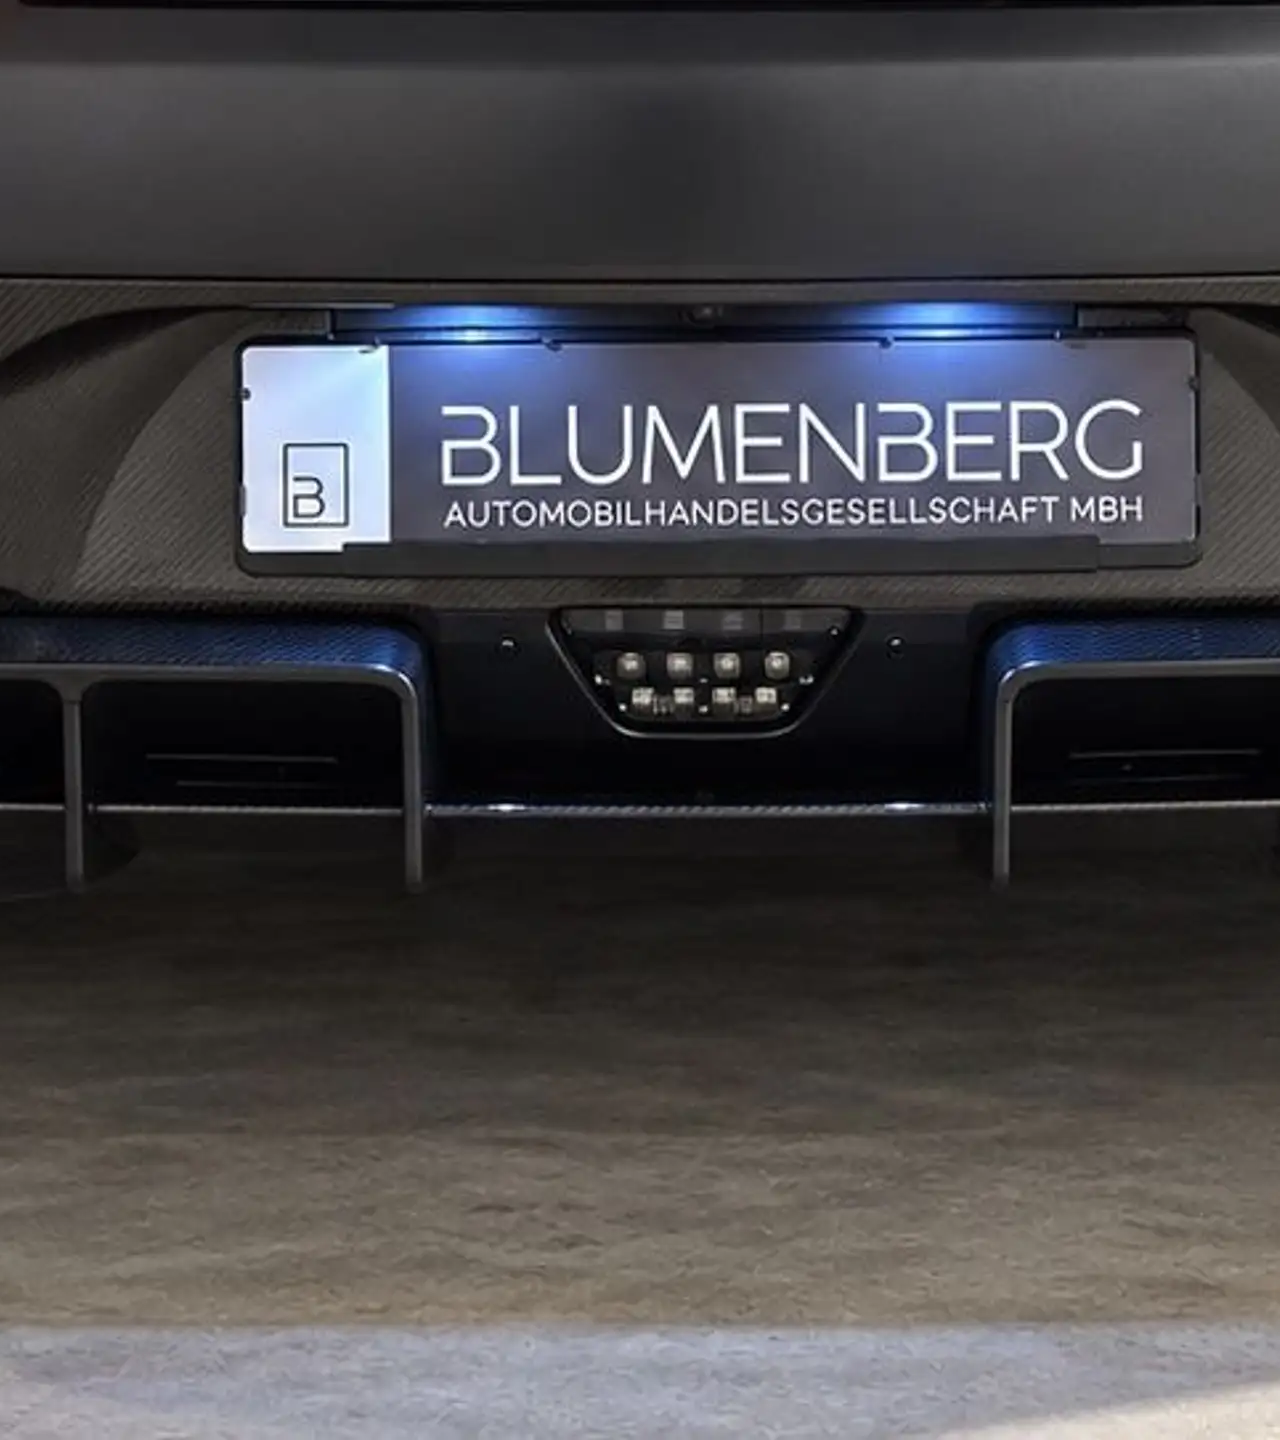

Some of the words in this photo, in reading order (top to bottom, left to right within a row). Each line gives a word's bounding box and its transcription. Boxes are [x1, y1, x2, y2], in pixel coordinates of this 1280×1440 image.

[440, 398, 1145, 487] BLUMENBERG
[292, 475, 326, 519] B
[443, 495, 1060, 530] AUTOMOBILHANDELSGESELLSCHAFT
[1069, 494, 1145, 523] MBH
